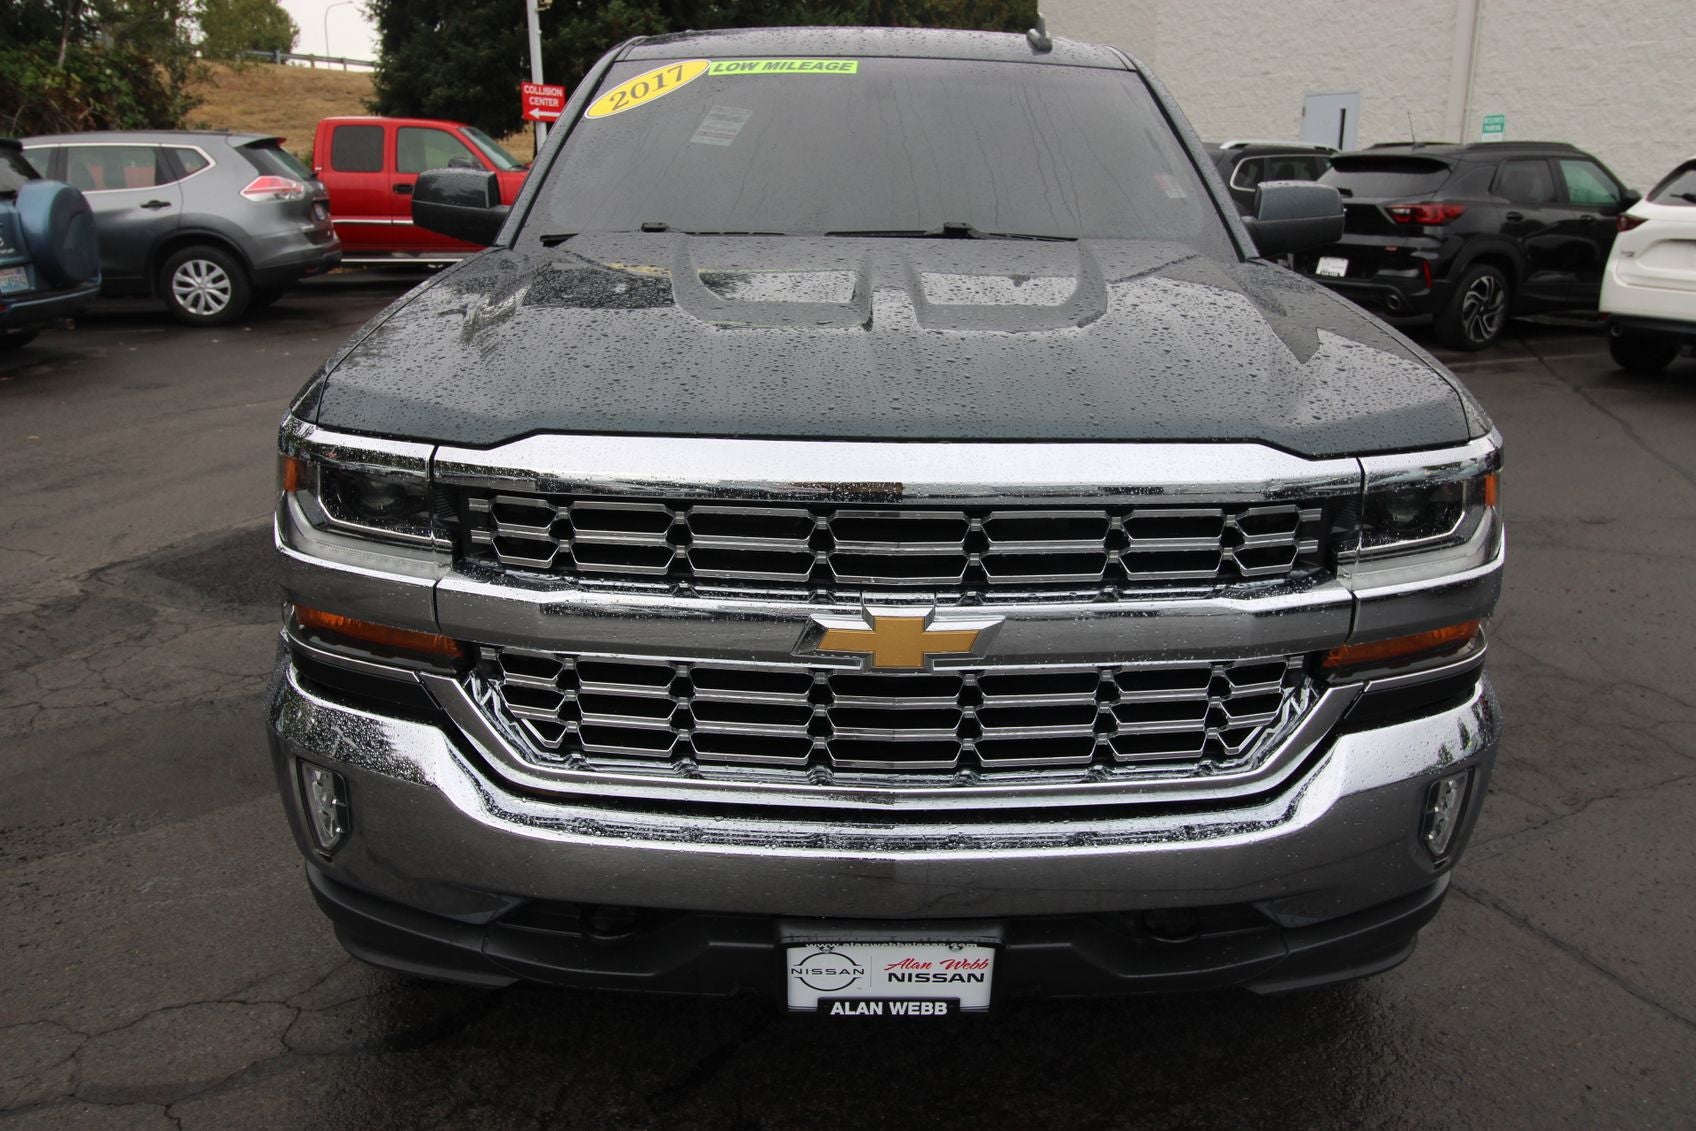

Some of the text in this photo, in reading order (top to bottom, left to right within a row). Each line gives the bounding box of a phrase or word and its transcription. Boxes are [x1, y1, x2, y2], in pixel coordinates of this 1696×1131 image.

[713, 61, 854, 73] LOW MILEAGE
[523, 84, 564, 97] COLLISION
[609, 64, 684, 112] 2017
[528, 96, 560, 107] CENTER
[883, 958, 989, 971] Alan Webb
[791, 968, 864, 976] NISSAN
[887, 972, 985, 983] NISSAN
[830, 1001, 948, 1016] ALAN WEBB
